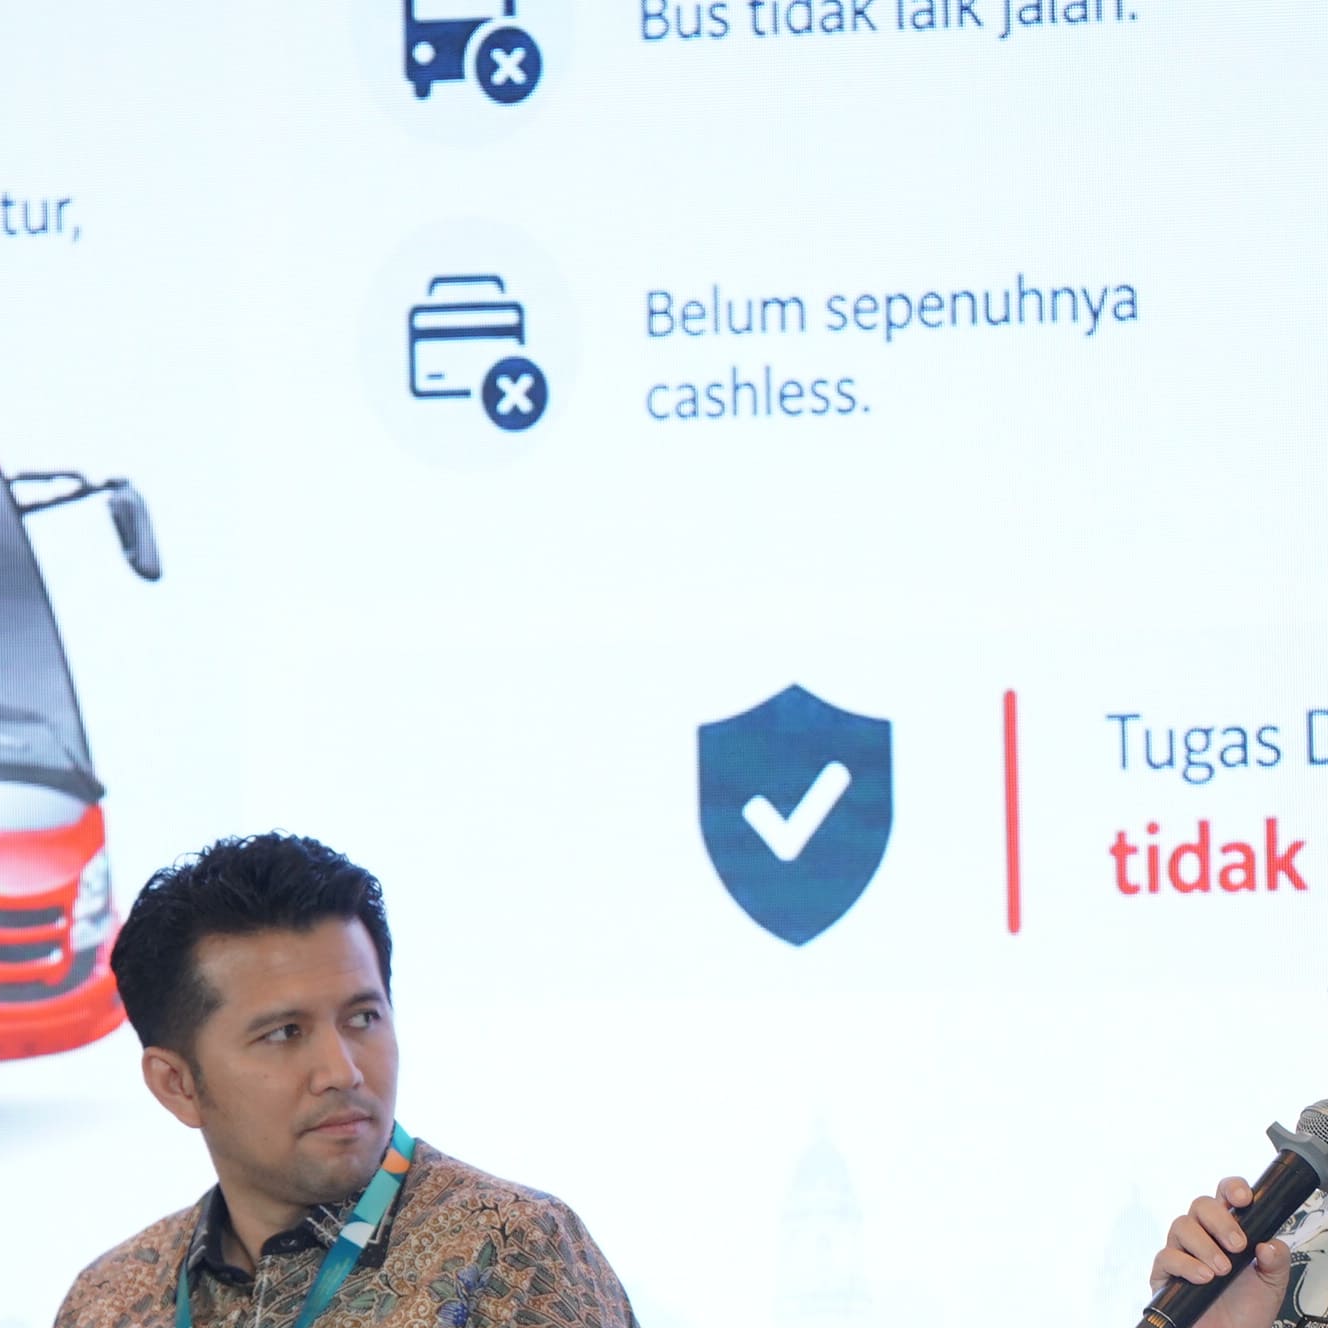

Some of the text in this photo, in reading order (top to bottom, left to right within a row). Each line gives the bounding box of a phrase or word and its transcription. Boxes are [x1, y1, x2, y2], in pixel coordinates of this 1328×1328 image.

[640, 0, 731, 41] Bus
[748, 0, 878, 38] tidak
[645, 273, 1138, 343] Belum sepenuhnya
[646, 365, 871, 422] cashless.
[1106, 712, 1283, 785] Tugas
[1109, 817, 1309, 896] tidak
